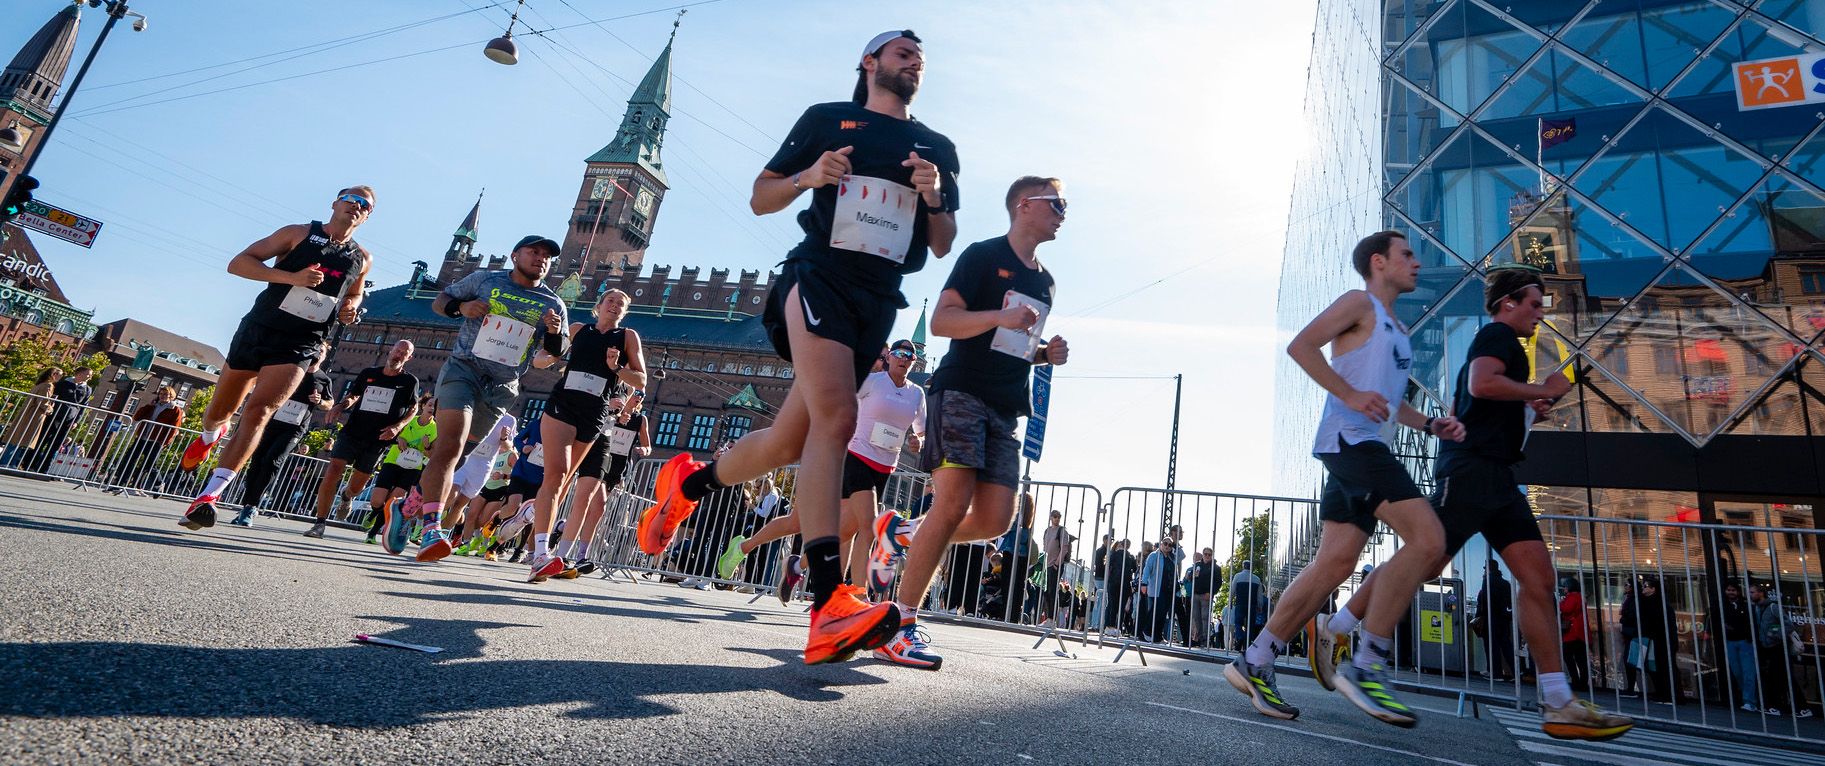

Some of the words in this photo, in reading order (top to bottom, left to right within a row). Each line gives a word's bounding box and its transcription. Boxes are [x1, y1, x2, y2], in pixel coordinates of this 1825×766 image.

[25, 201, 46, 214] E20
[57, 214, 70, 222] 21
[18, 213, 44, 227] Bella
[48, 223, 83, 239] Center
[856, 211, 899, 231] Maxime
[304, 295, 324, 307] Philip
[501, 292, 546, 307] SCOTT
[486, 336, 505, 346] Jorge
[505, 341, 519, 351] Luis
